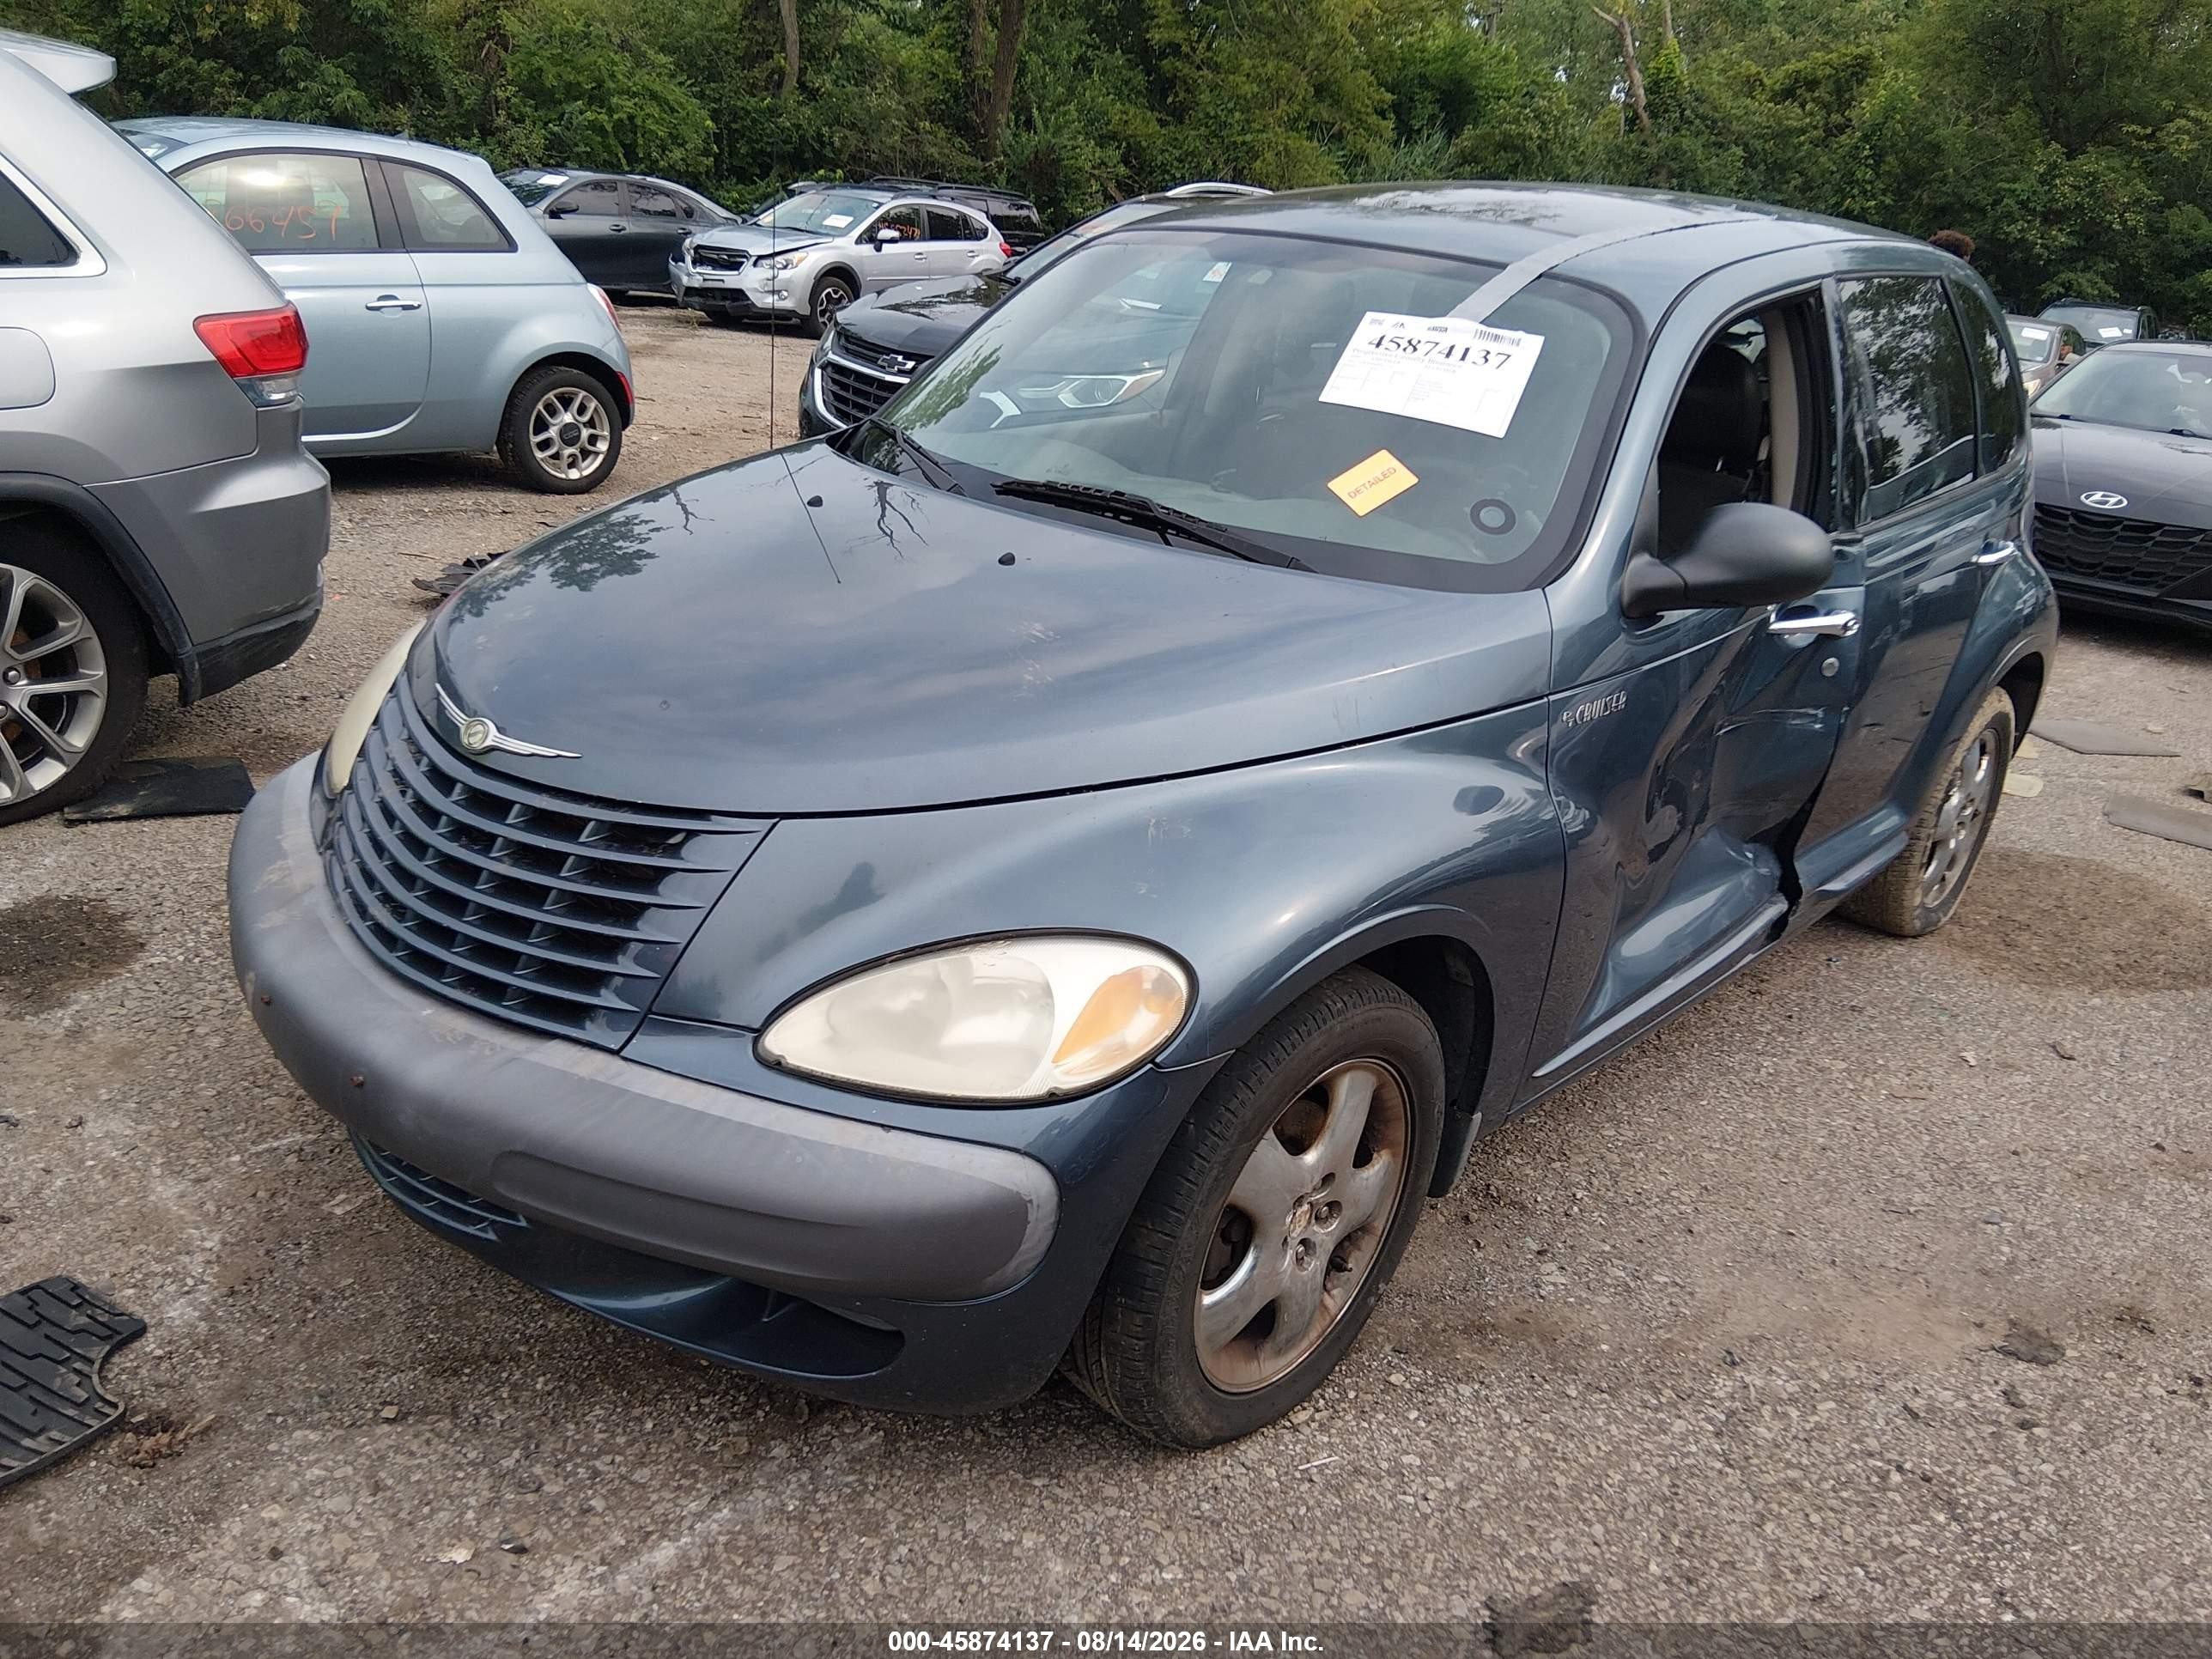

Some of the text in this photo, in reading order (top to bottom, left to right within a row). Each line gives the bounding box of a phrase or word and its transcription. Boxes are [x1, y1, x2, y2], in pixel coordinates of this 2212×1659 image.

[1367, 334, 1511, 370] 45874137
[1346, 465, 1397, 500] DETAILED
[1576, 690, 1627, 724] CRUISER
